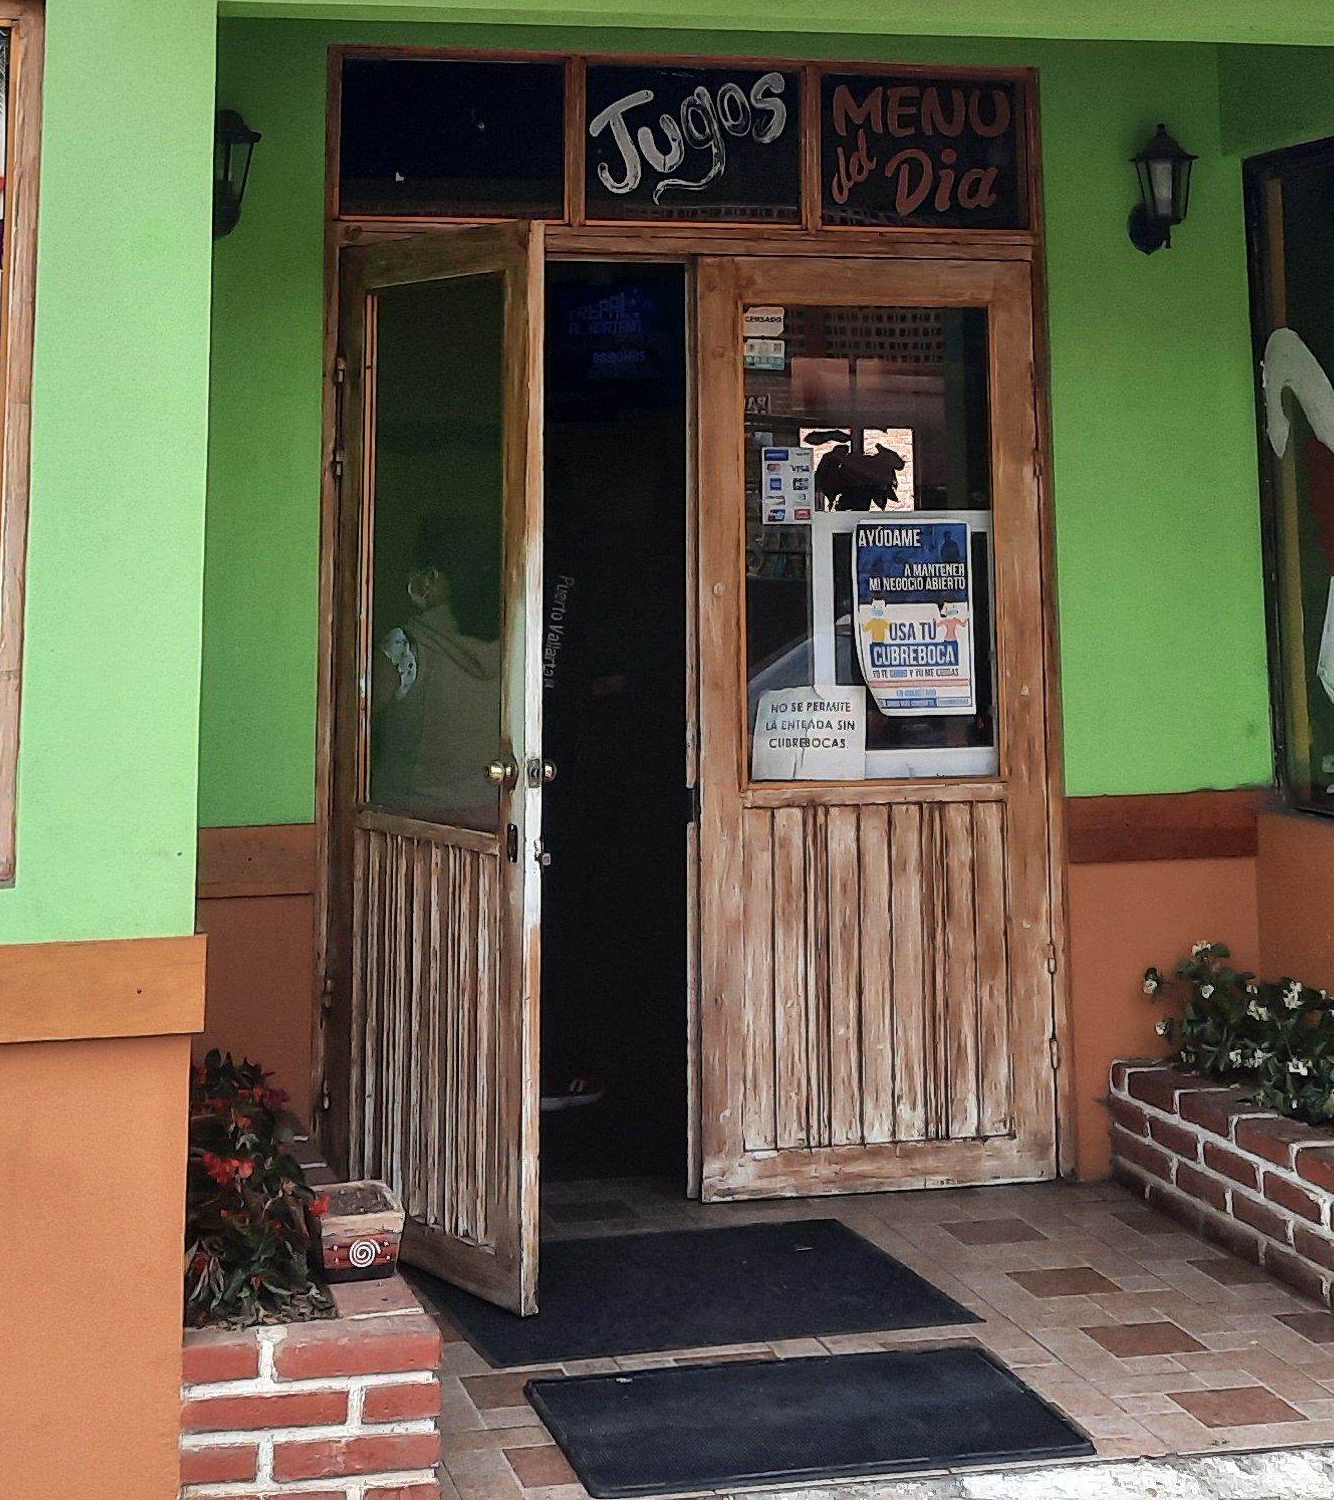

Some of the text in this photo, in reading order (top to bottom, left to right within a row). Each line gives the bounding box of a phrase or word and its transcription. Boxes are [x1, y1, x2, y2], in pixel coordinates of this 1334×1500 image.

[832, 84, 1012, 138] MENU
[589, 71, 786, 205] Jugos
[884, 148, 998, 217] Dia
[858, 526, 921, 547] AYÚDAME
[905, 563, 965, 577] A MANTENER
[869, 576, 966, 591] MI NEGOCIO ABIERTO
[889, 622, 916, 641] USA
[873, 645, 956, 665] CUBREBOCA
[771, 703, 787, 713] NO
[791, 702, 803, 712] SE
[766, 720, 777, 731] LA
[837, 720, 855, 730] SIN
